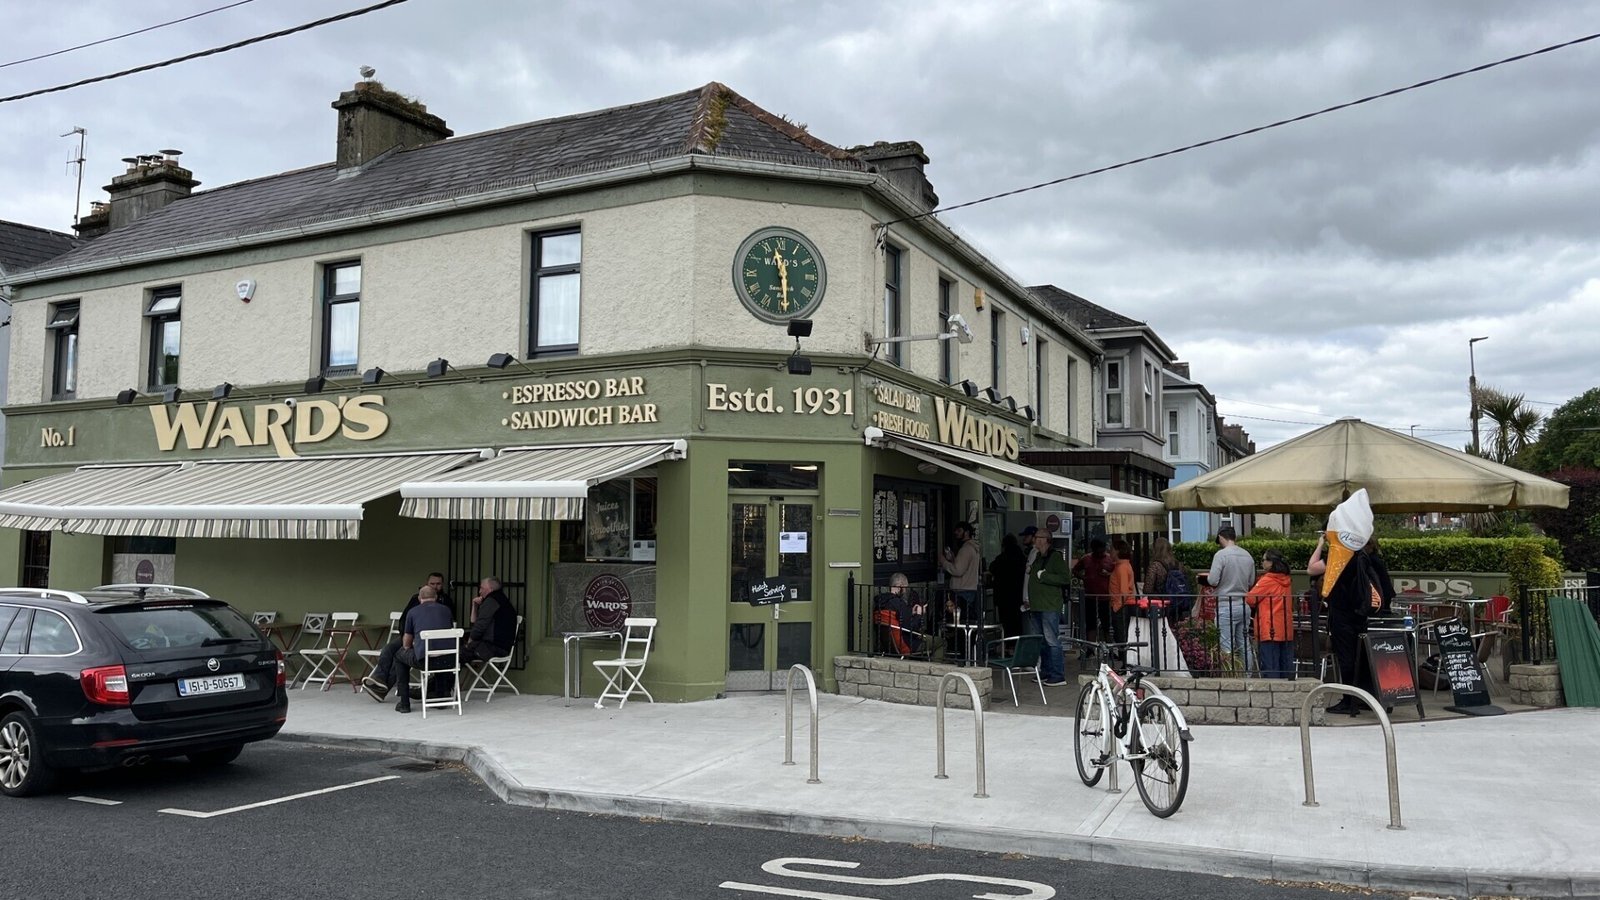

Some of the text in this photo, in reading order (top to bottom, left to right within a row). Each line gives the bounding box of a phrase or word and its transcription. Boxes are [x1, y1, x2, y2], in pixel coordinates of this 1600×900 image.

[764, 258, 799, 267] WAD'S
[512, 376, 645, 405] ESPRESSO BAR
[706, 383, 855, 416] Estd. 1931
[877, 385, 921, 413] SALAD BAR
[149, 395, 390, 458] WARD'S
[511, 403, 658, 430] SANDWICH BAR
[877, 410, 930, 440] FRESH FOODS
[934, 396, 1019, 461] WARD'S
[41, 425, 75, 448] No. 1
[763, 584, 787, 597] Service
[1393, 578, 1473, 597] RD'S
[586, 599, 629, 612] WARD'S
[188, 677, 239, 693] 151-D-50657
